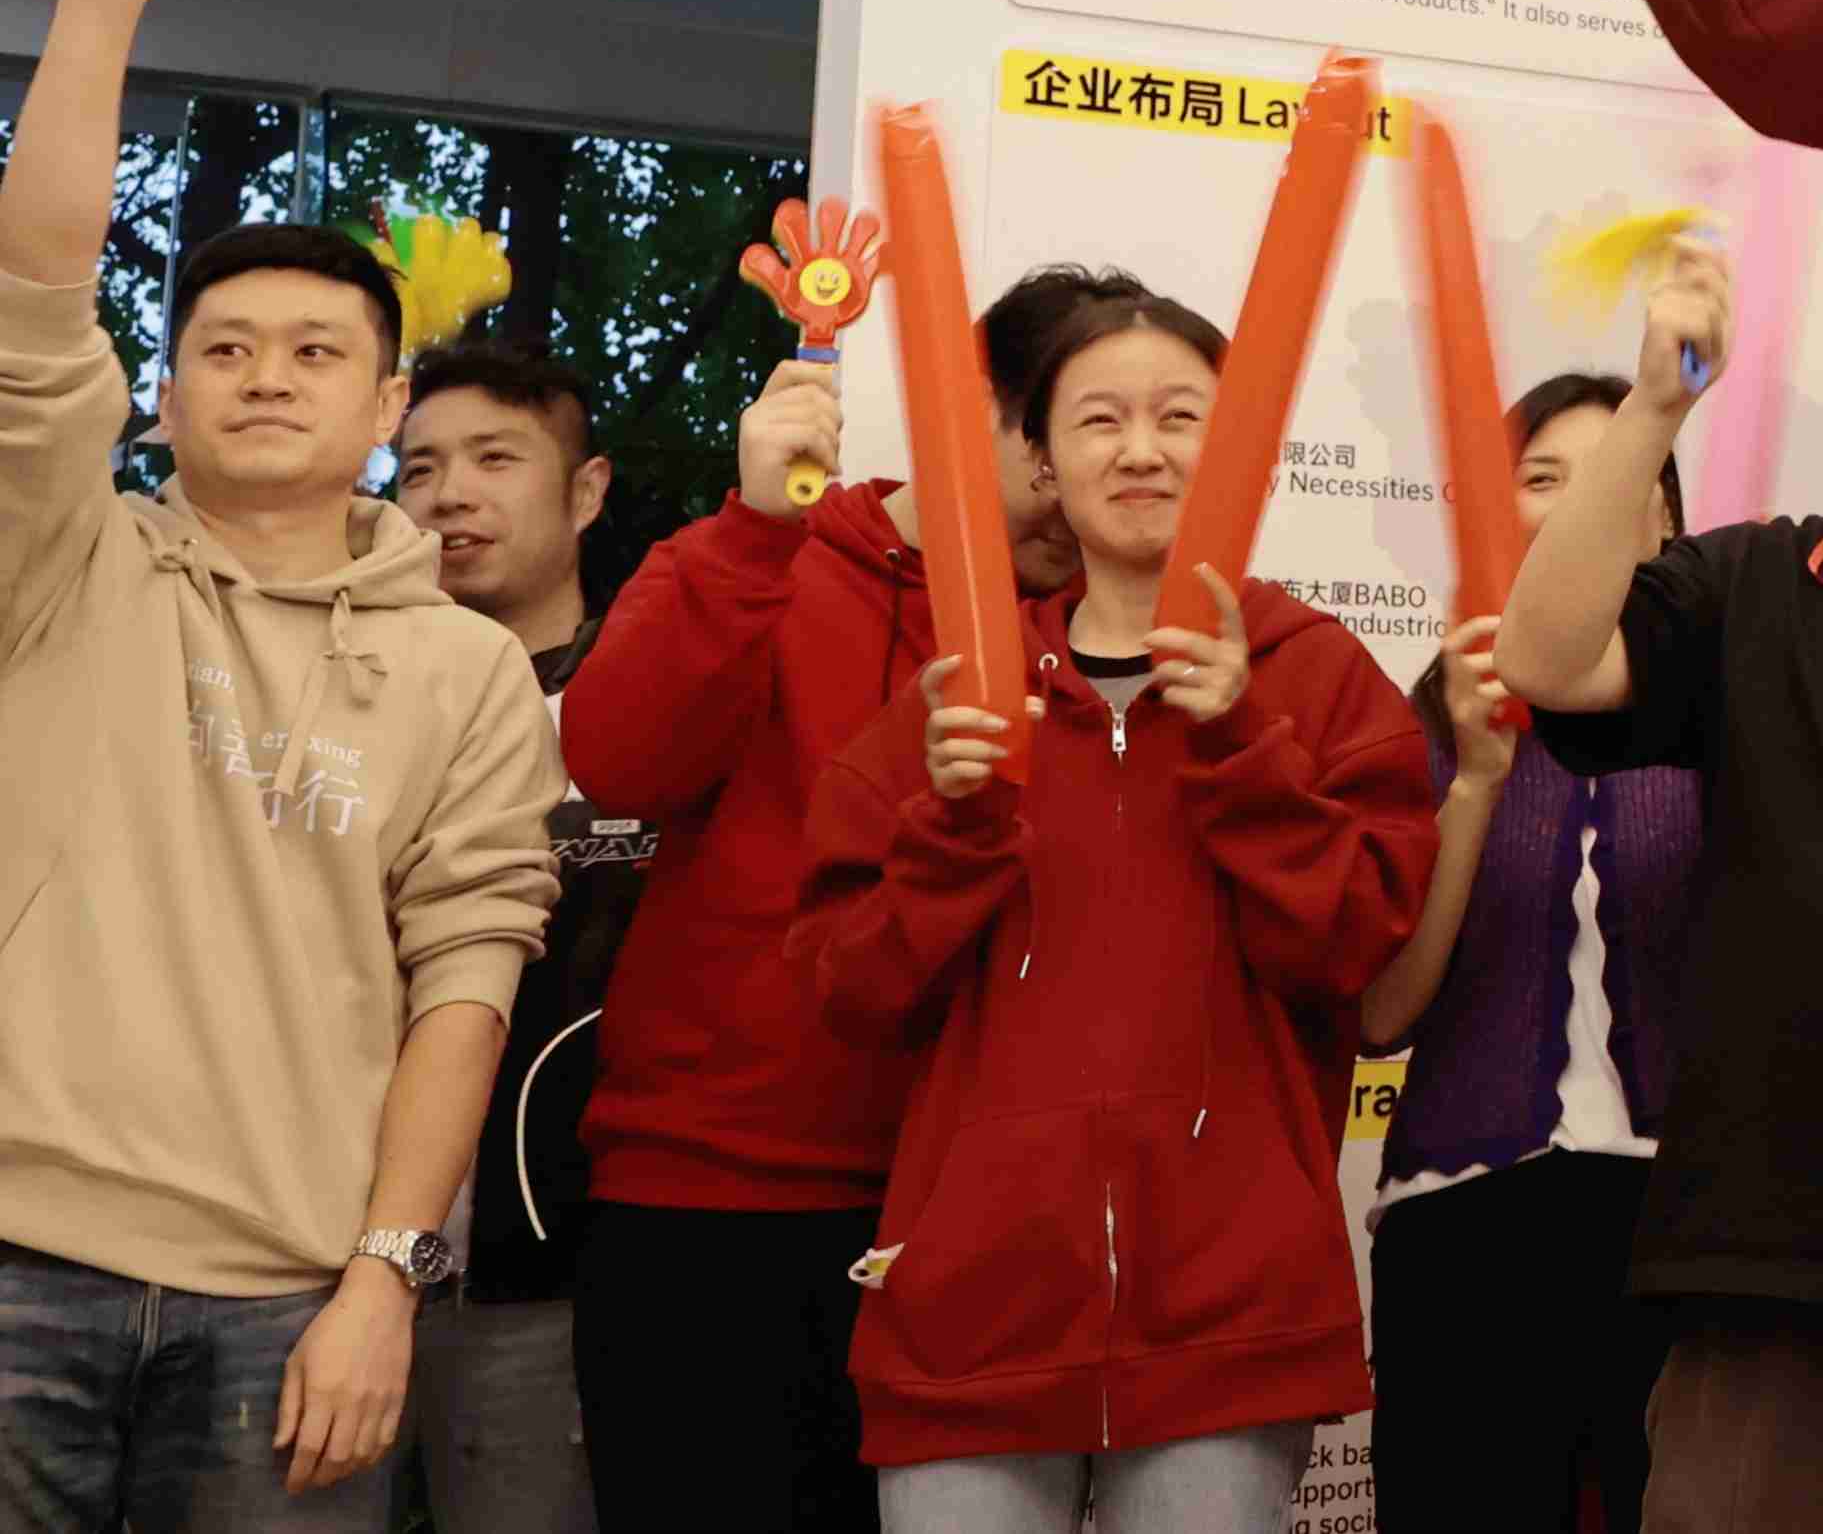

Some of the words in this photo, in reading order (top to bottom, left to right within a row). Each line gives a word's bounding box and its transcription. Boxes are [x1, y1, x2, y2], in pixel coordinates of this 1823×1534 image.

[1525, 1, 1570, 28] also
[1576, 11, 1647, 39] serves
[1024, 59, 1225, 128] 企业布局
[1289, 470, 1434, 503] Necessities
